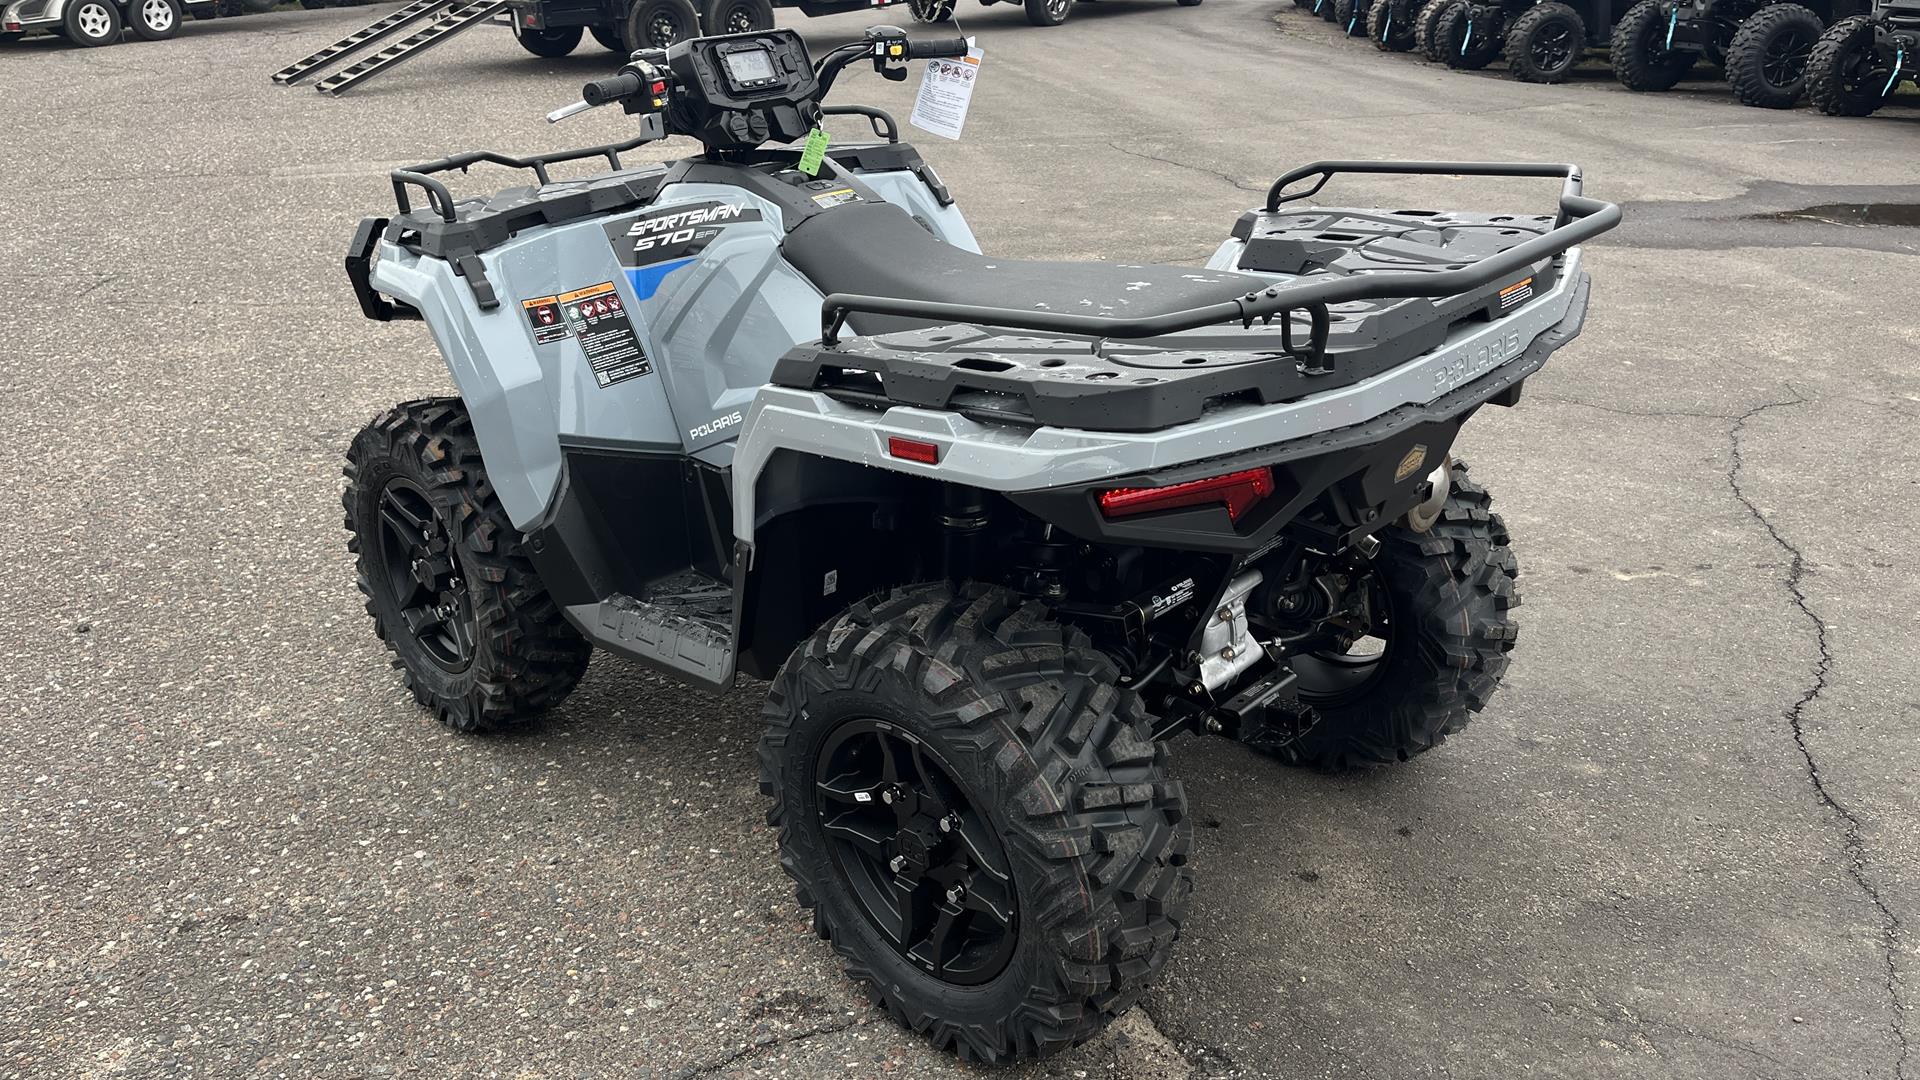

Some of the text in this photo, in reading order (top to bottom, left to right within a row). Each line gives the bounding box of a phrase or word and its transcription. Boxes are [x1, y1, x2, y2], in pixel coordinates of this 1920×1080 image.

[627, 202, 744, 237] SPORTSMAN
[633, 228, 718, 252] 570 EFI
[1432, 328, 1520, 394] POLARIS
[689, 411, 743, 440] POLARIS
